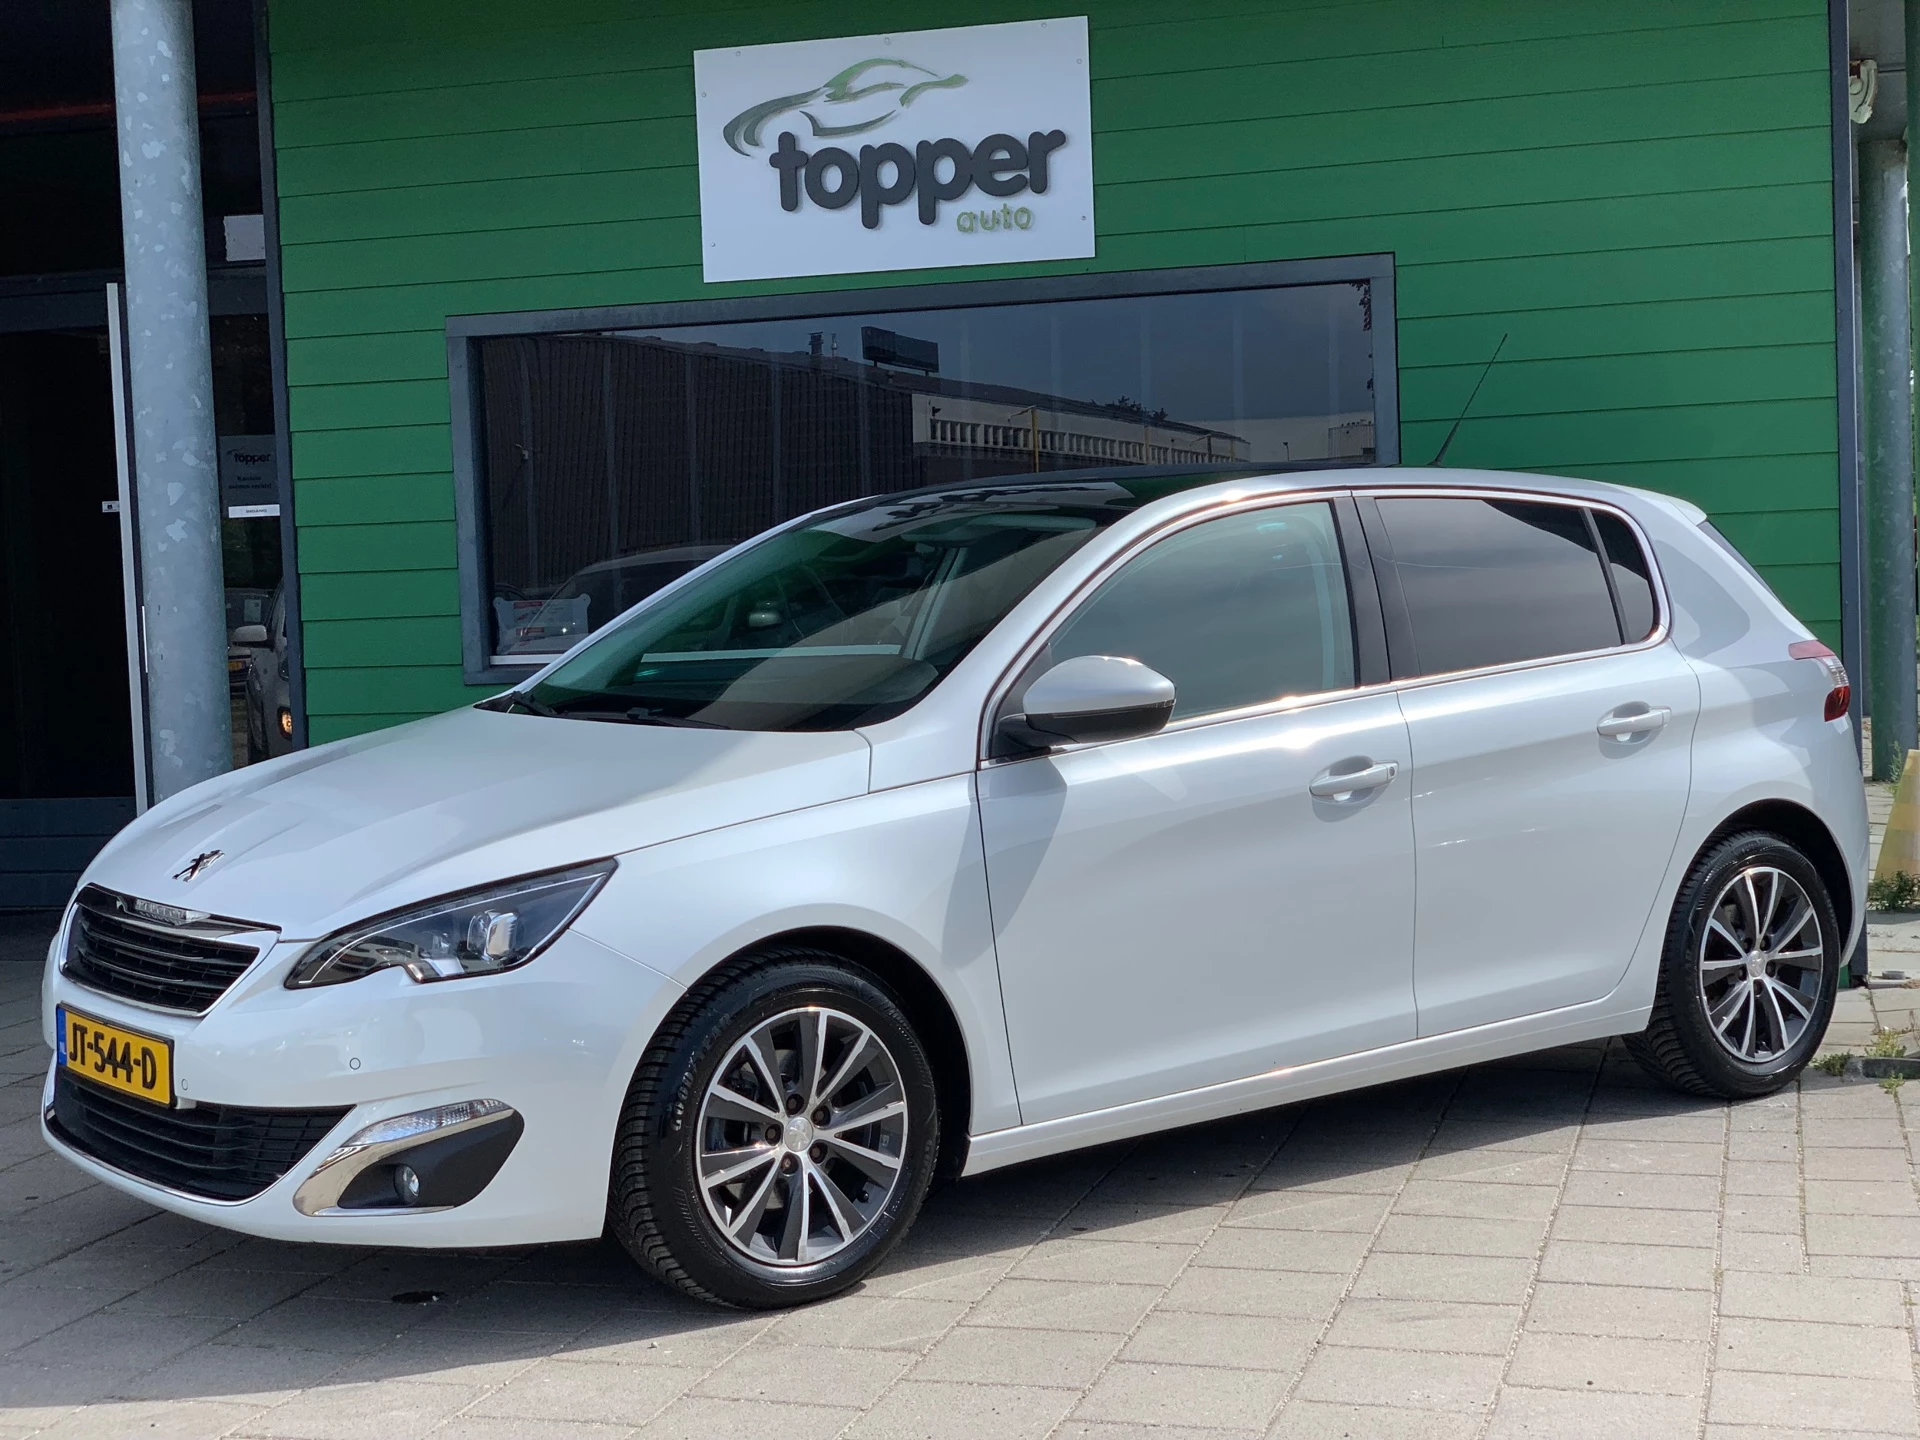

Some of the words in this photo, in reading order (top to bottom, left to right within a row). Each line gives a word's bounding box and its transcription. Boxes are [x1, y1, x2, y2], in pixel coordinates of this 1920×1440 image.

[769, 129, 1066, 230] topper
[956, 203, 1032, 233] auto
[233, 453, 272, 465] topper
[69, 1022, 157, 1090] JT-544-D
